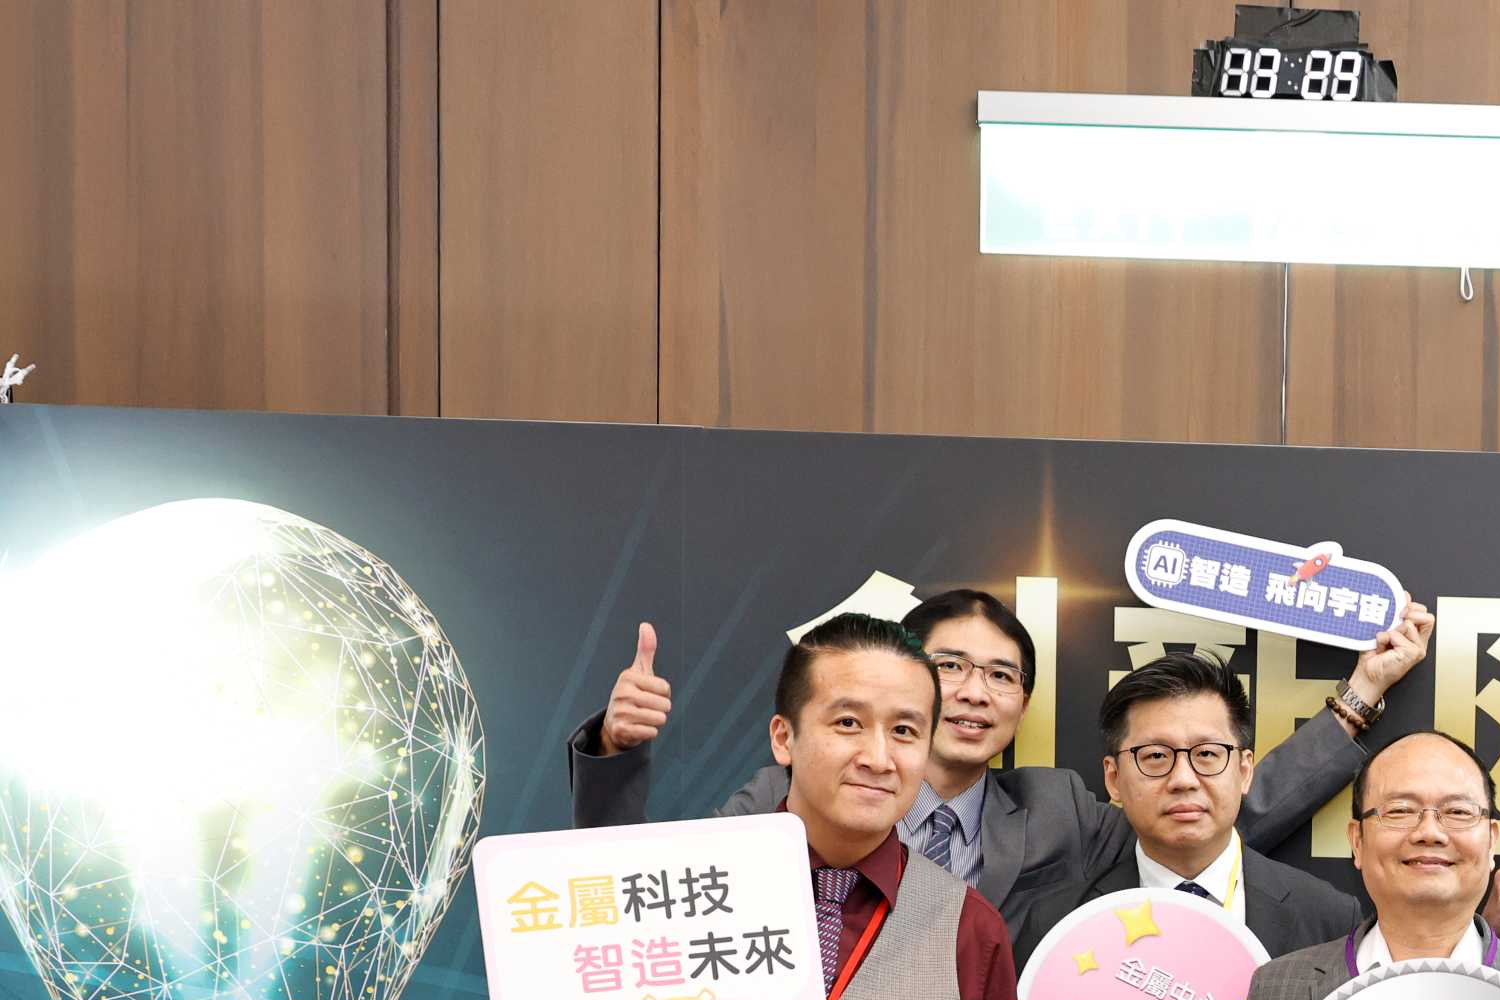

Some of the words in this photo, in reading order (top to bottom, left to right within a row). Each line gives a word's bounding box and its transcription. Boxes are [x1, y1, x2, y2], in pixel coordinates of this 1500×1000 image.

[1265, 572, 1390, 626] 飛向宇宙
[507, 865, 733, 933] 金屬科技
[573, 925, 796, 993] 智造未來
